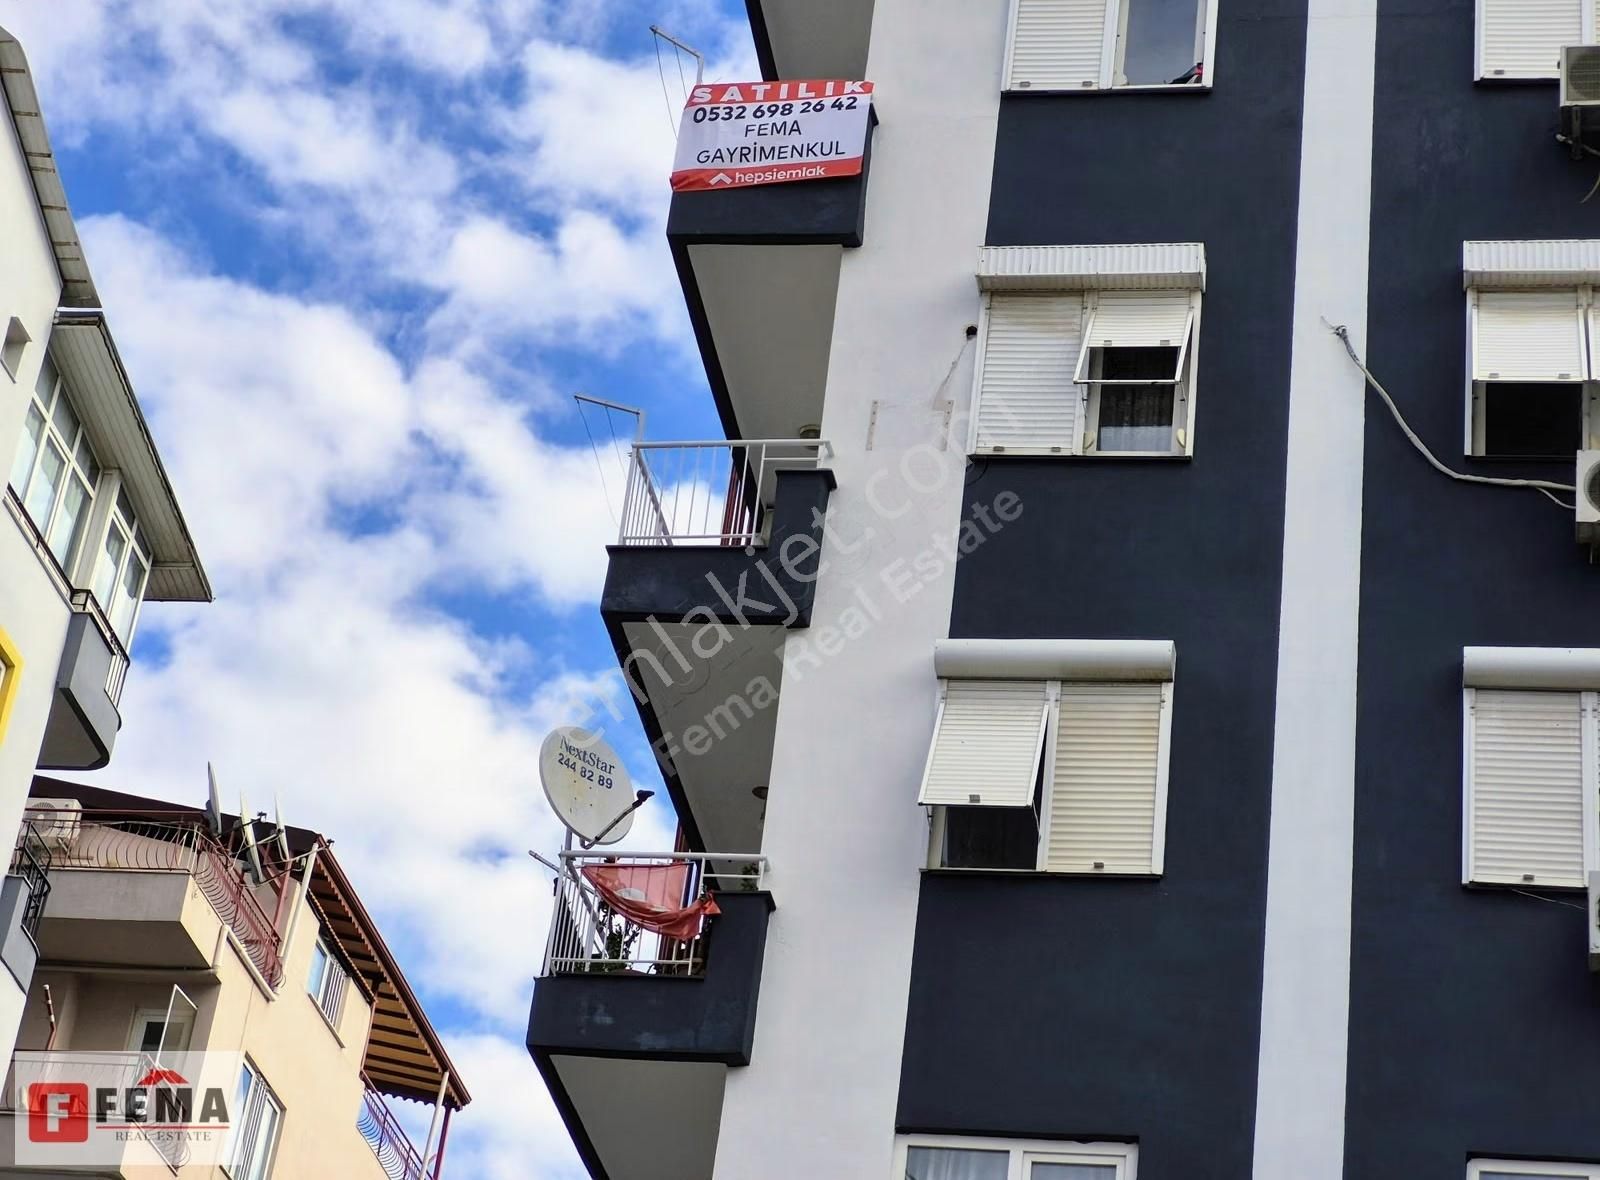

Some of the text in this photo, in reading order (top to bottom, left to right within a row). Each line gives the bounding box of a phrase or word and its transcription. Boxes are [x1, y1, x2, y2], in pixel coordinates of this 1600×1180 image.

[692, 81, 865, 103] SATILIK
[692, 96, 858, 124] 0532 698 26 42
[744, 120, 802, 138] FEMA
[696, 141, 845, 163] GAYRİMENKUL
[735, 166, 825, 184] hepsiemlak
[560, 735, 615, 775] NextStar
[558, 753, 613, 789] 244 82 89
